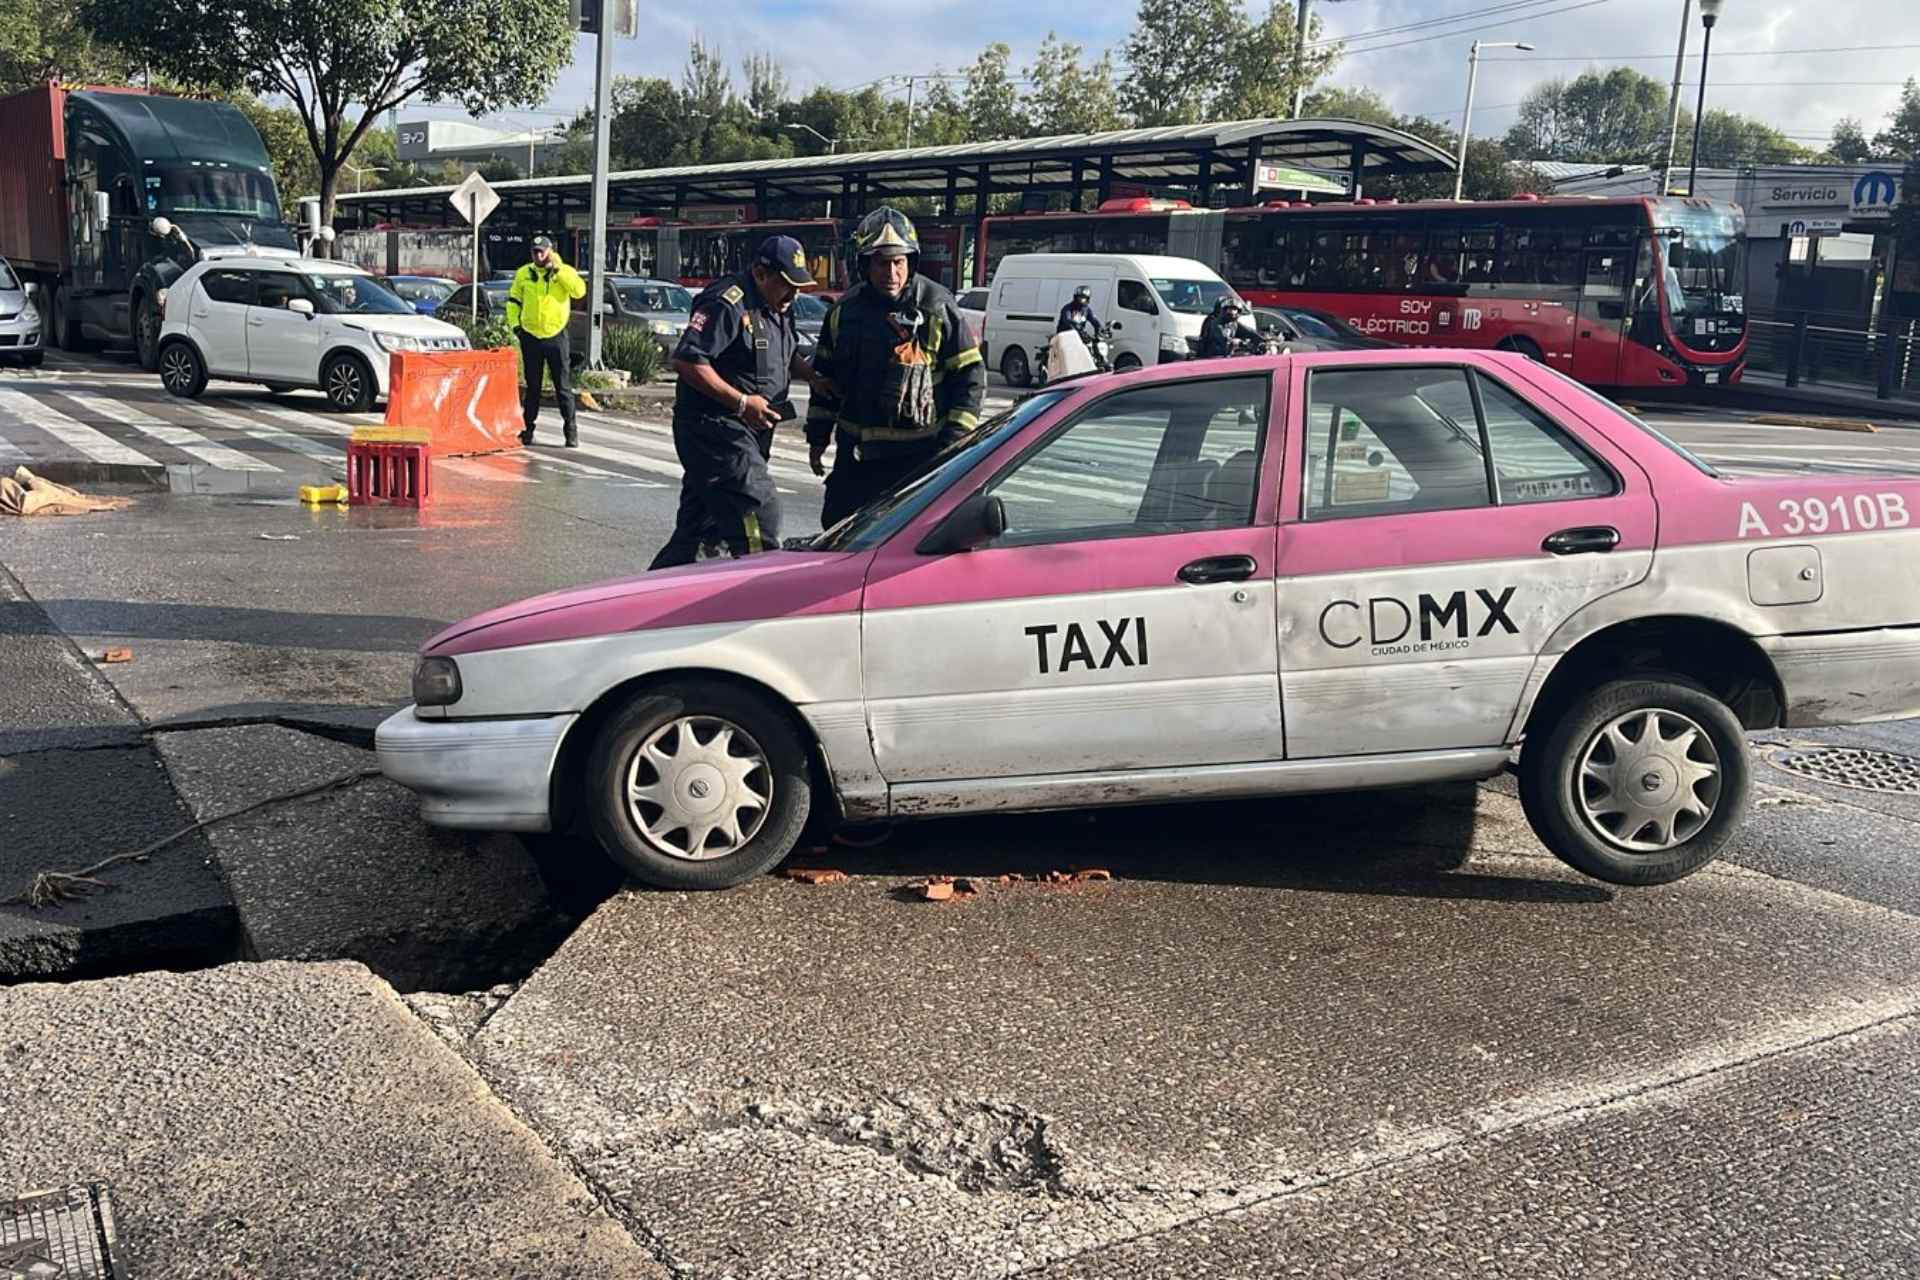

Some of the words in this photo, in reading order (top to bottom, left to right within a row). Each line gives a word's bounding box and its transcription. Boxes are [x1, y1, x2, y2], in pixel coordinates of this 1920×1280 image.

[402, 131, 425, 145] BYD
[1772, 187, 1838, 201] Servicio
[1401, 300, 1431, 314] SOY
[1738, 501, 1771, 537] A
[1778, 493, 1910, 534] 3910B
[1319, 586, 1520, 648] CDMX
[1024, 617, 1149, 673] TAXI
[1371, 645, 1410, 656] CIUDAD
[1413, 643, 1427, 653] DE
[1430, 639, 1470, 651] MÉXICO
